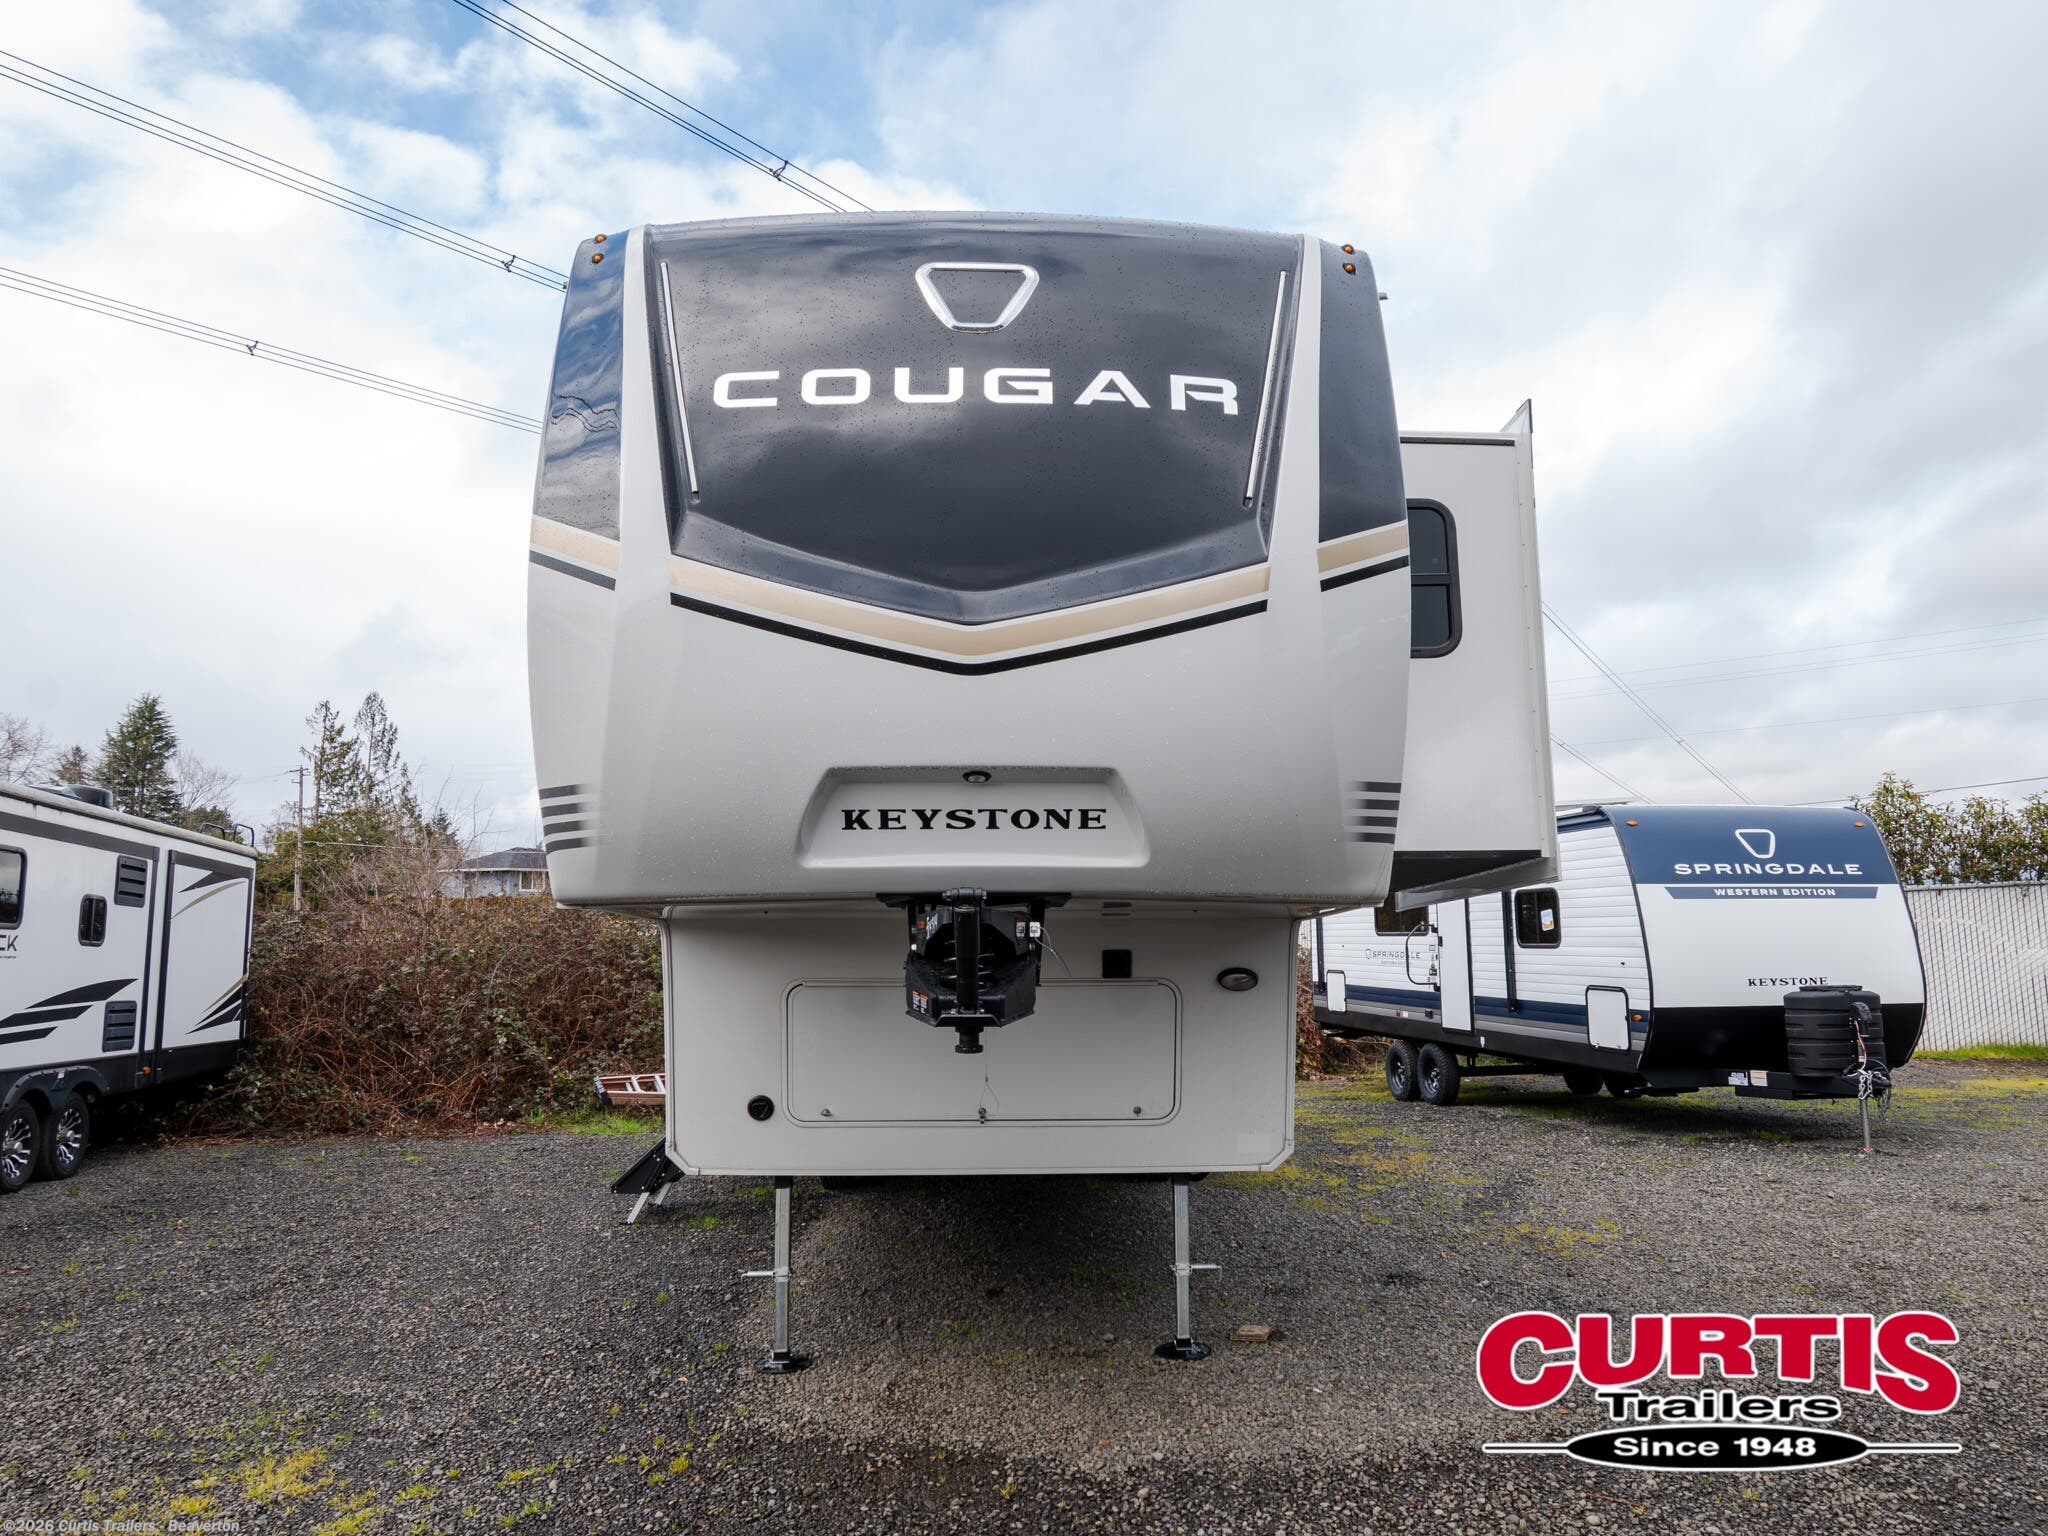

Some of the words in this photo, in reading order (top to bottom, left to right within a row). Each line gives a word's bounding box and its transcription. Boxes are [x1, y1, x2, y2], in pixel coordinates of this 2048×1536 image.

[713, 366, 1239, 416] COUGAR
[840, 808, 1108, 831] KEYSTONE
[1673, 862, 1863, 876] SPRINGDALE
[1713, 888, 1778, 896] WESTERN
[1782, 888, 1837, 896] EDITION
[1372, 951, 1420, 959] SPRINGDLE
[1747, 976, 1828, 987] KEYSTONE
